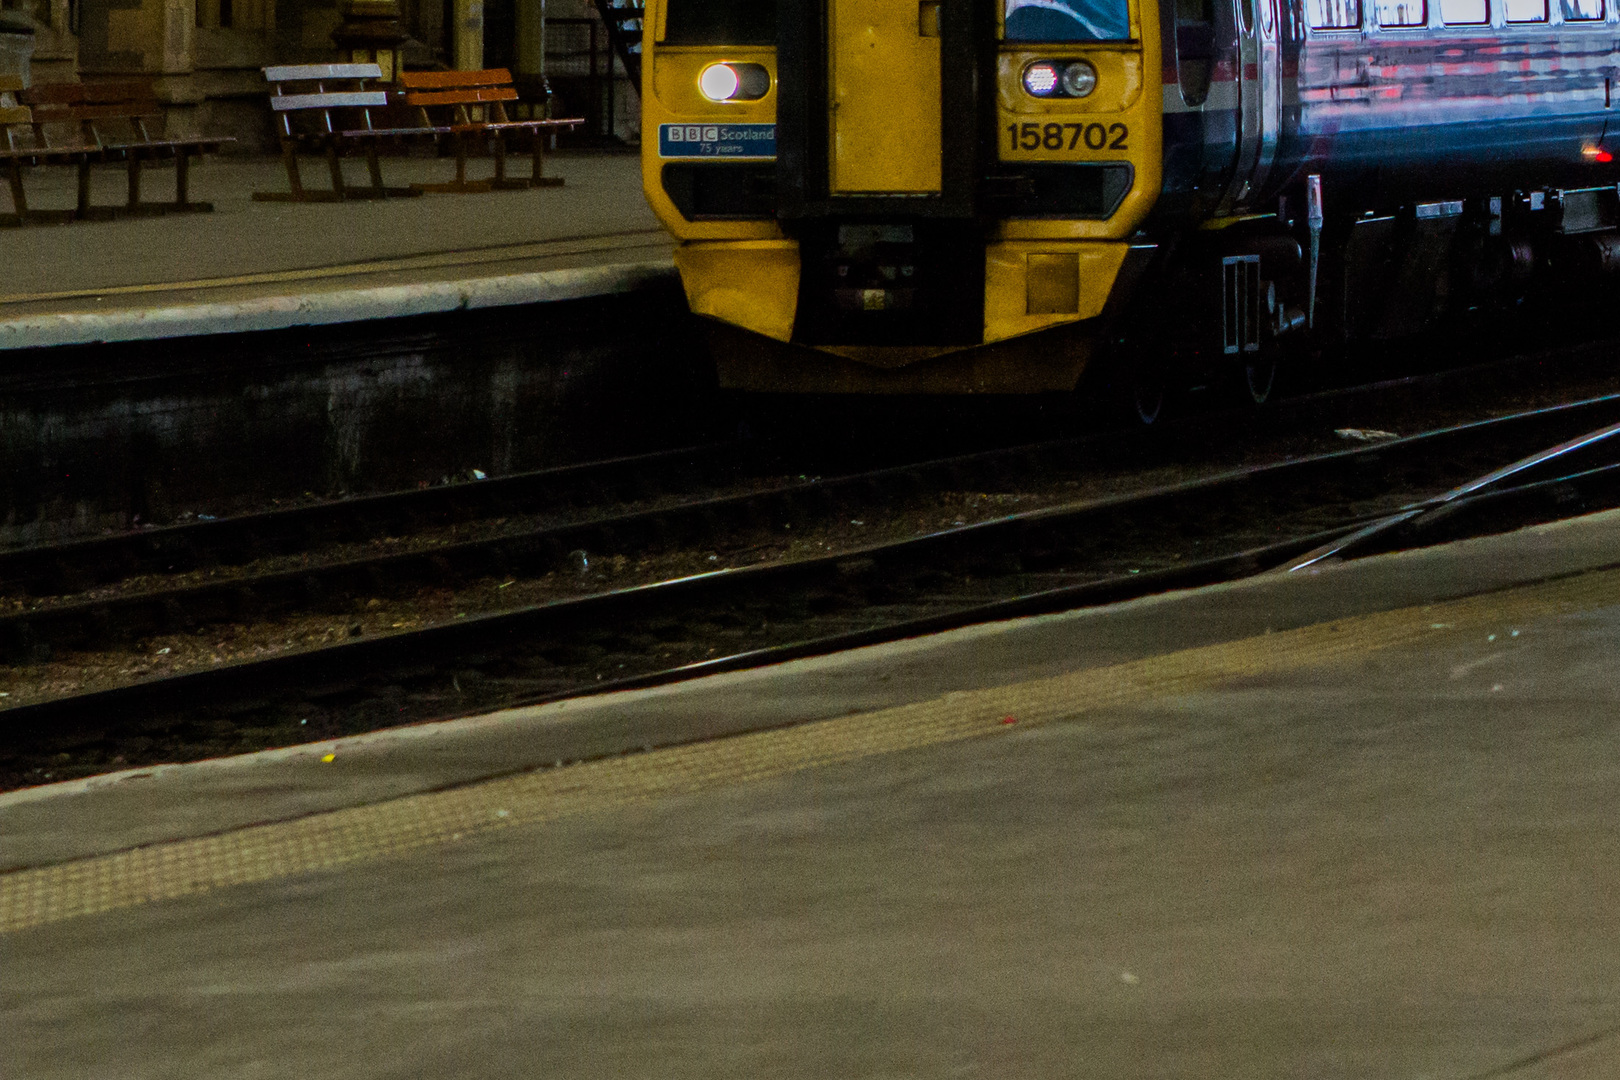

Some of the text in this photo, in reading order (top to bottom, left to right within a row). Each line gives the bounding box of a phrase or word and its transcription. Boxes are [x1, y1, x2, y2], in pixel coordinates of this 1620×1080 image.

[668, 127, 775, 142] BBC Scotland
[1006, 123, 1129, 151] 158702
[699, 143, 744, 156] 75 years
